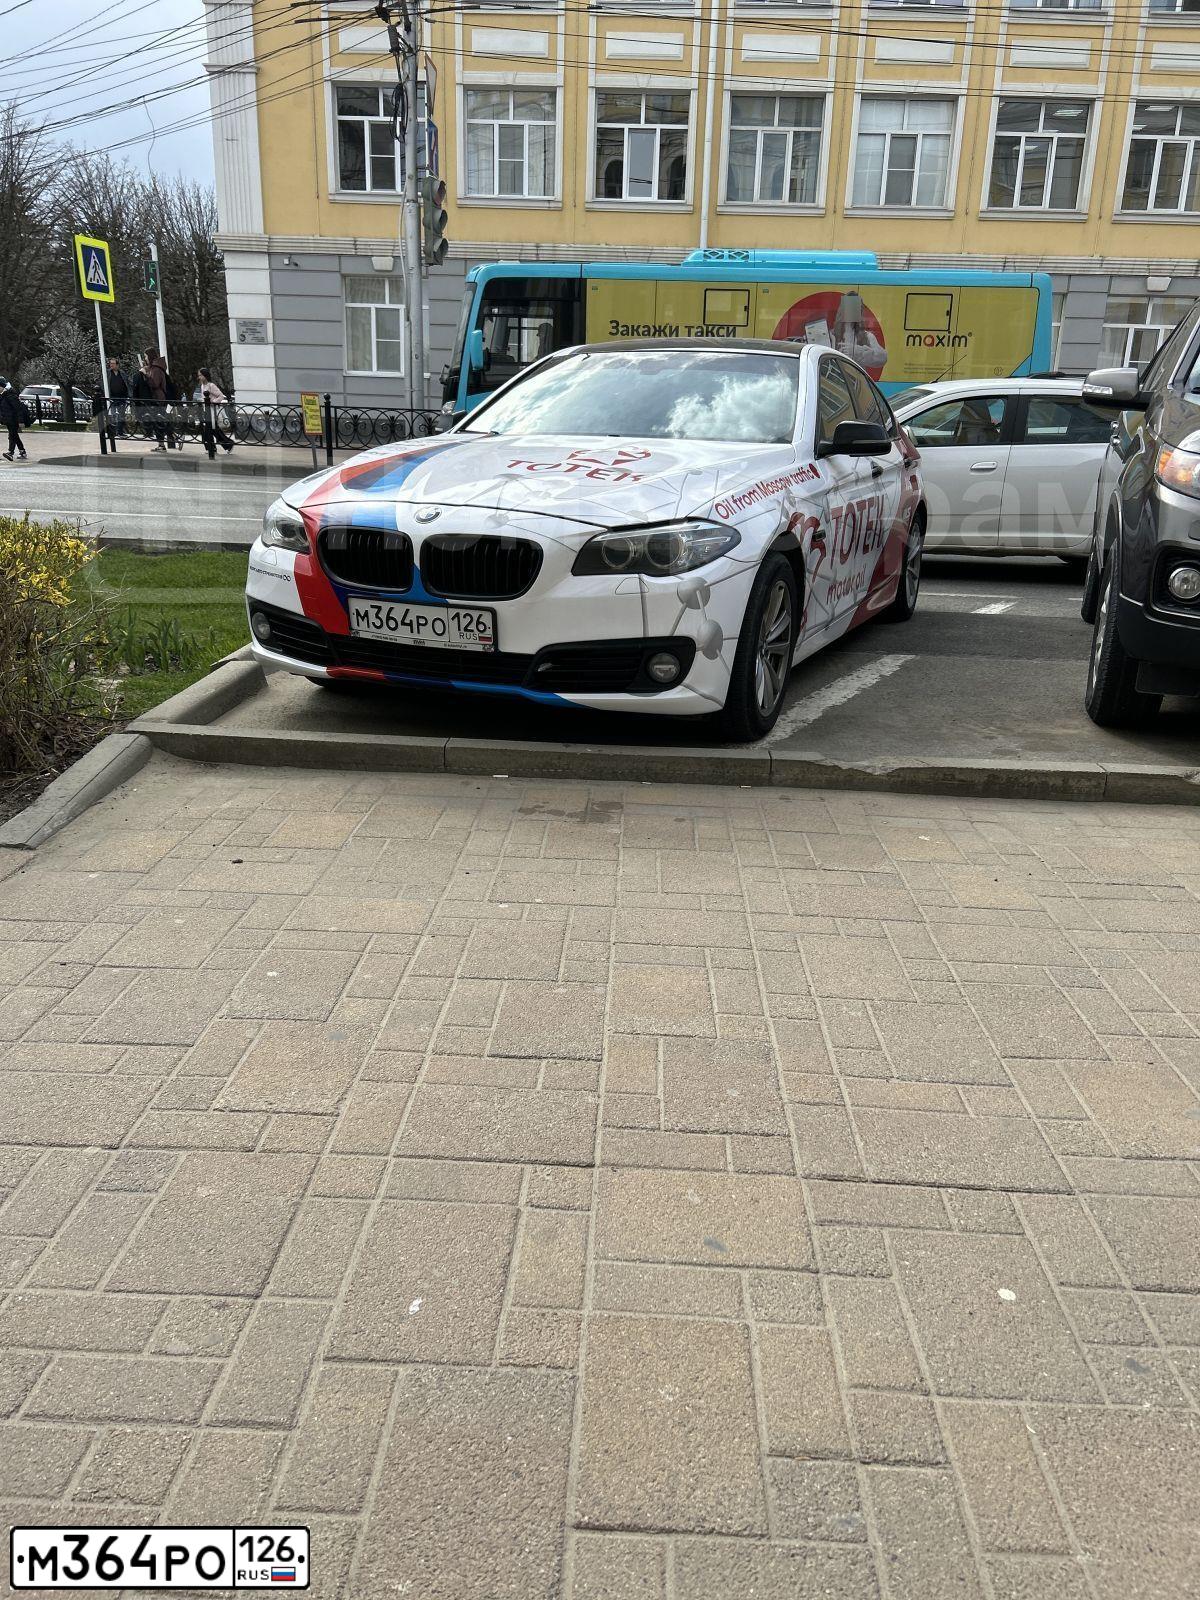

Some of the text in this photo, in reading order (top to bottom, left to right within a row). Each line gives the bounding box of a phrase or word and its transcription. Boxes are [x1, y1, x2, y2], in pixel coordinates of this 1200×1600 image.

[608, 320, 737, 338] Закажи такси
[906, 330, 968, 348] maxim
[714, 466, 815, 520] Oil from Moscow traffic
[355, 604, 447, 637] М364РО
[450, 611, 488, 633] 126
[459, 632, 478, 641] RUS
